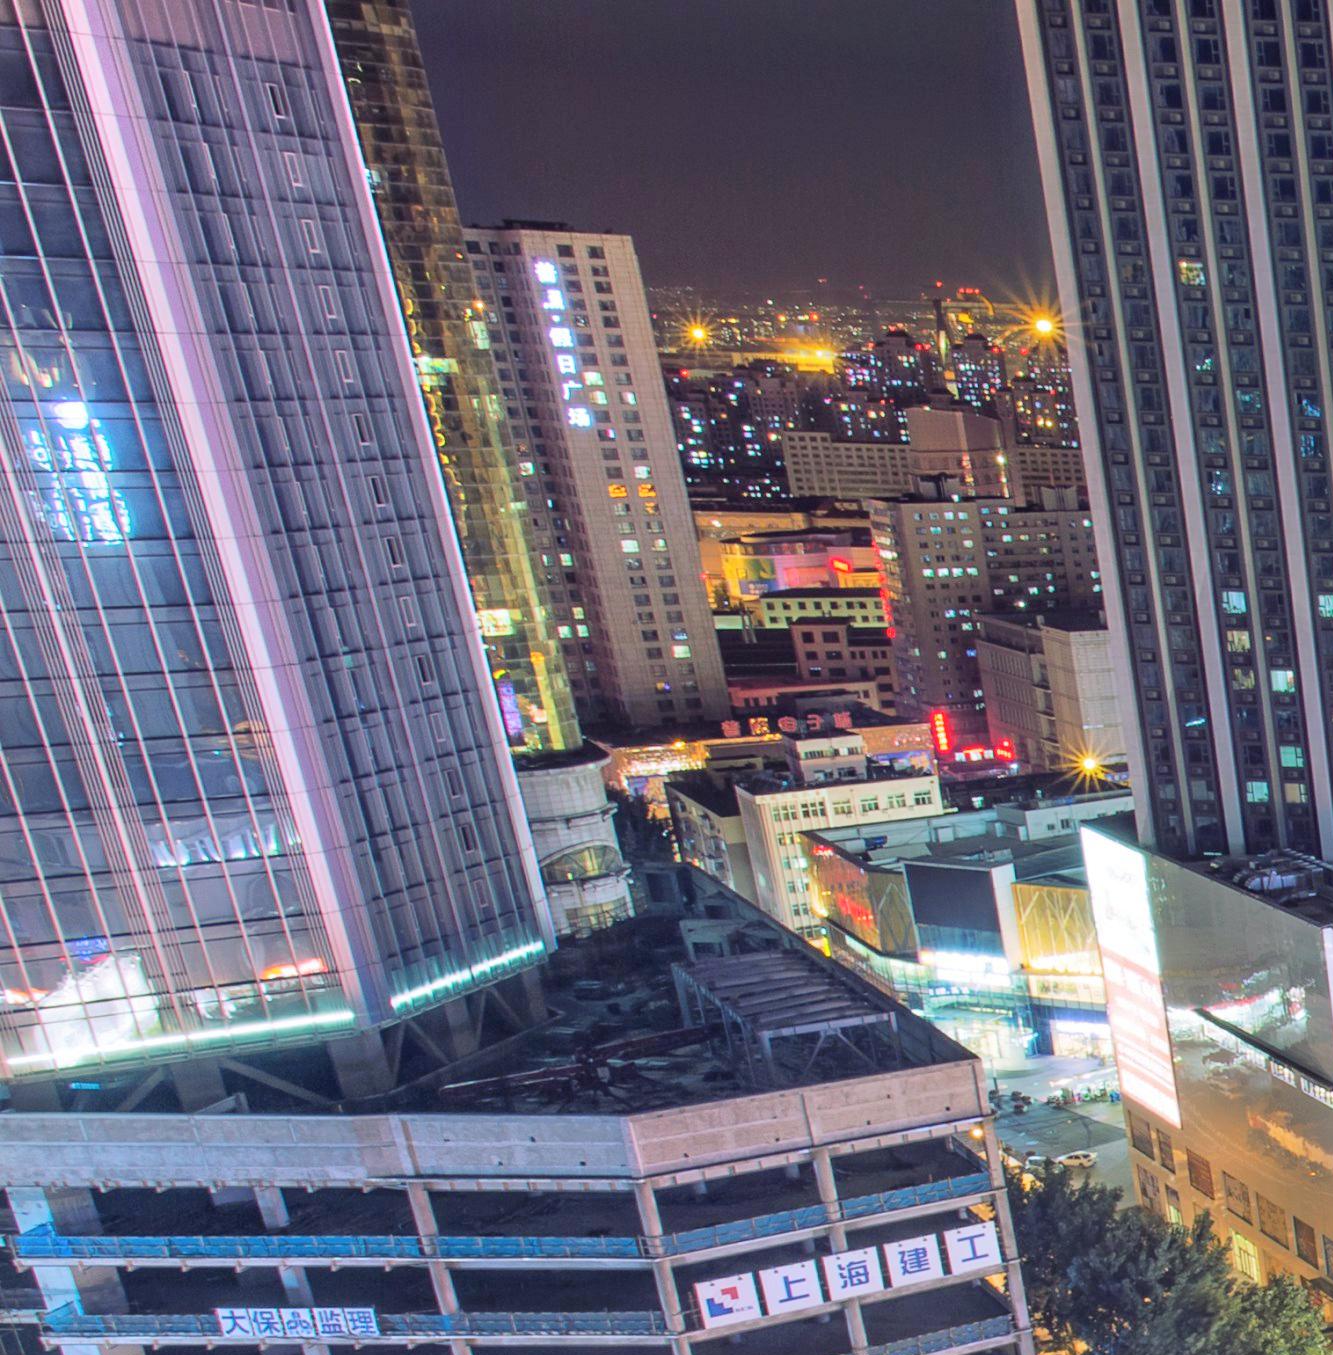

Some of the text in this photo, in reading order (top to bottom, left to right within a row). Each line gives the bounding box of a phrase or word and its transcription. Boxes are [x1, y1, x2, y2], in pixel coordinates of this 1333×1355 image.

[778, 1232, 990, 1304] 上海建工
[318, 1309, 377, 1335] 监理
